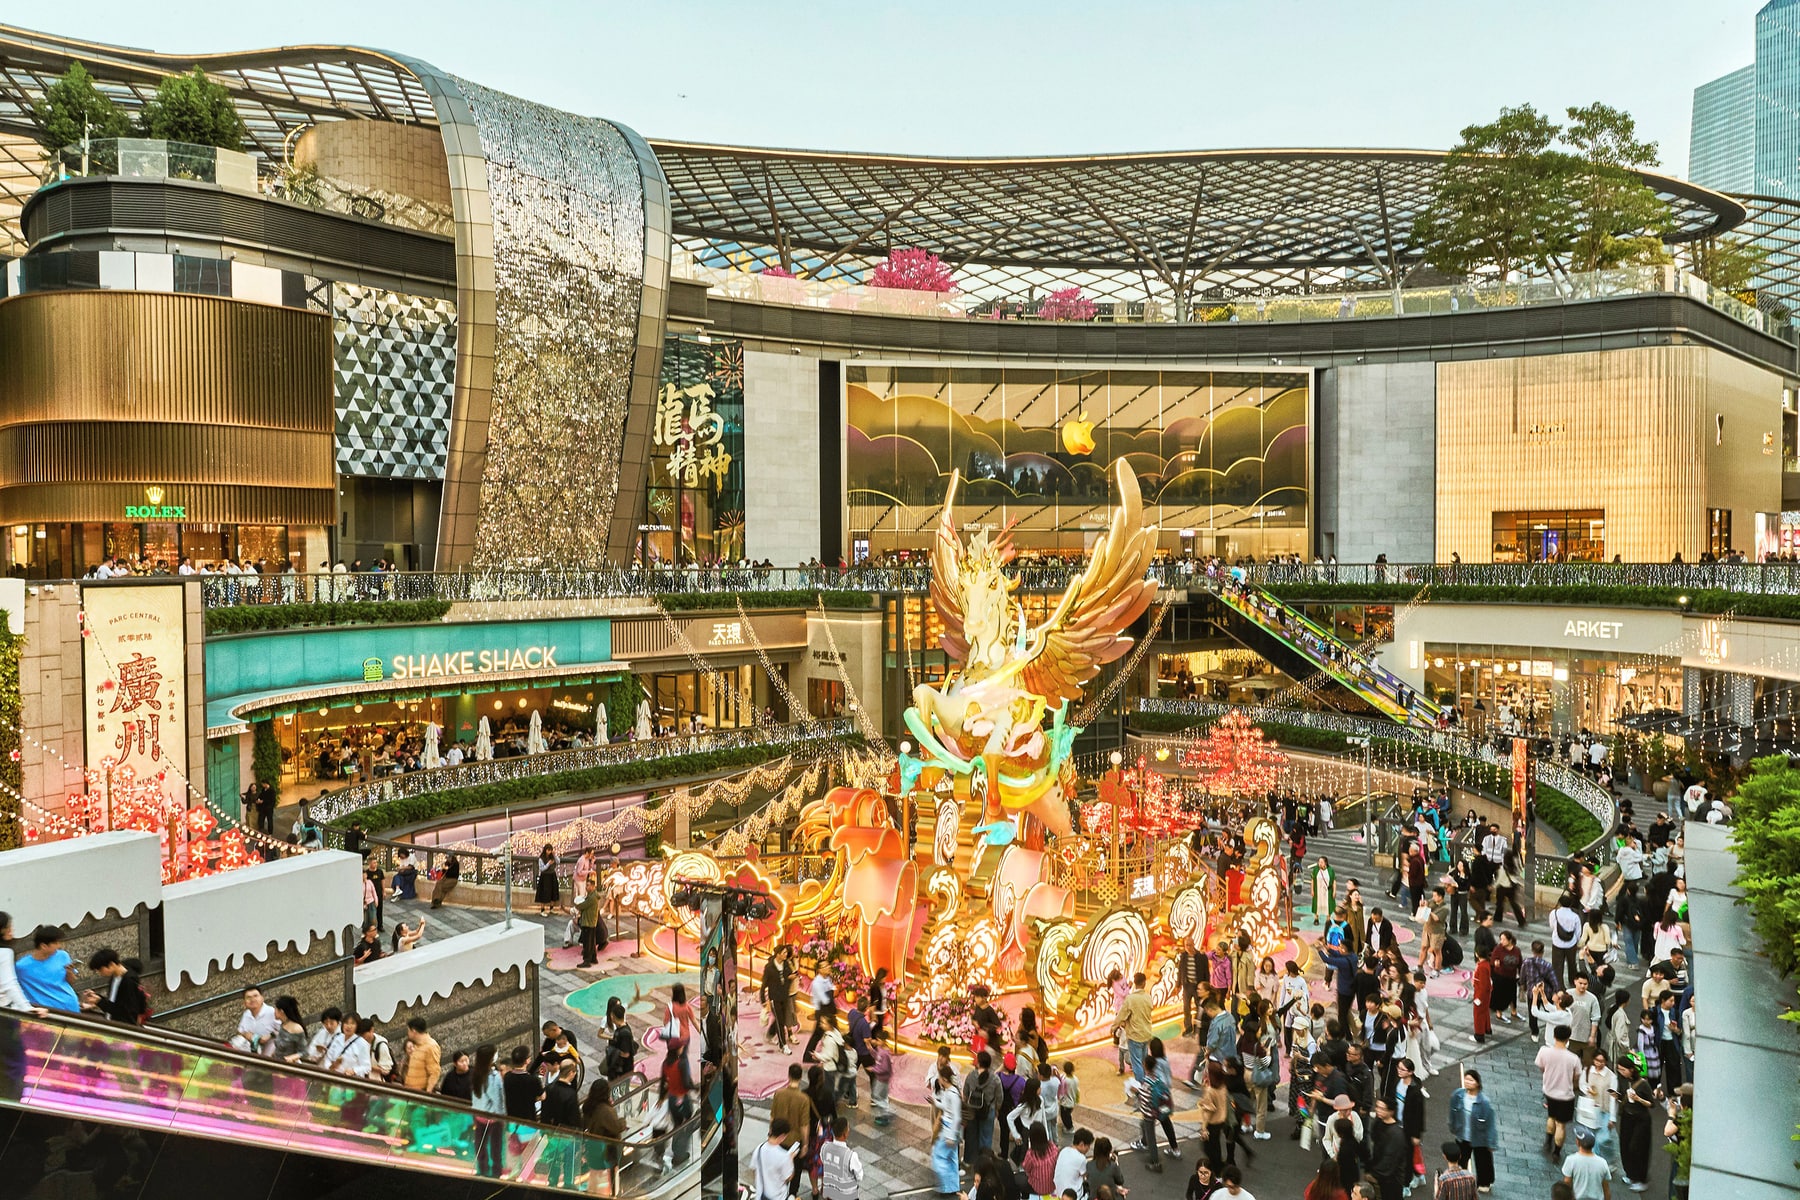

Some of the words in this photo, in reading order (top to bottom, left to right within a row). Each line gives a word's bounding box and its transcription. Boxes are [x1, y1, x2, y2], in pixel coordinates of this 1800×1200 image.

[125, 505, 186, 518] ROLEX
[109, 614, 128, 625] PARC
[130, 612, 161, 623] CENTRAL
[1563, 620, 1624, 639] ARKET
[392, 651, 475, 680] SHAKE
[478, 646, 557, 673] SHACK
[109, 652, 163, 766] 廣州
